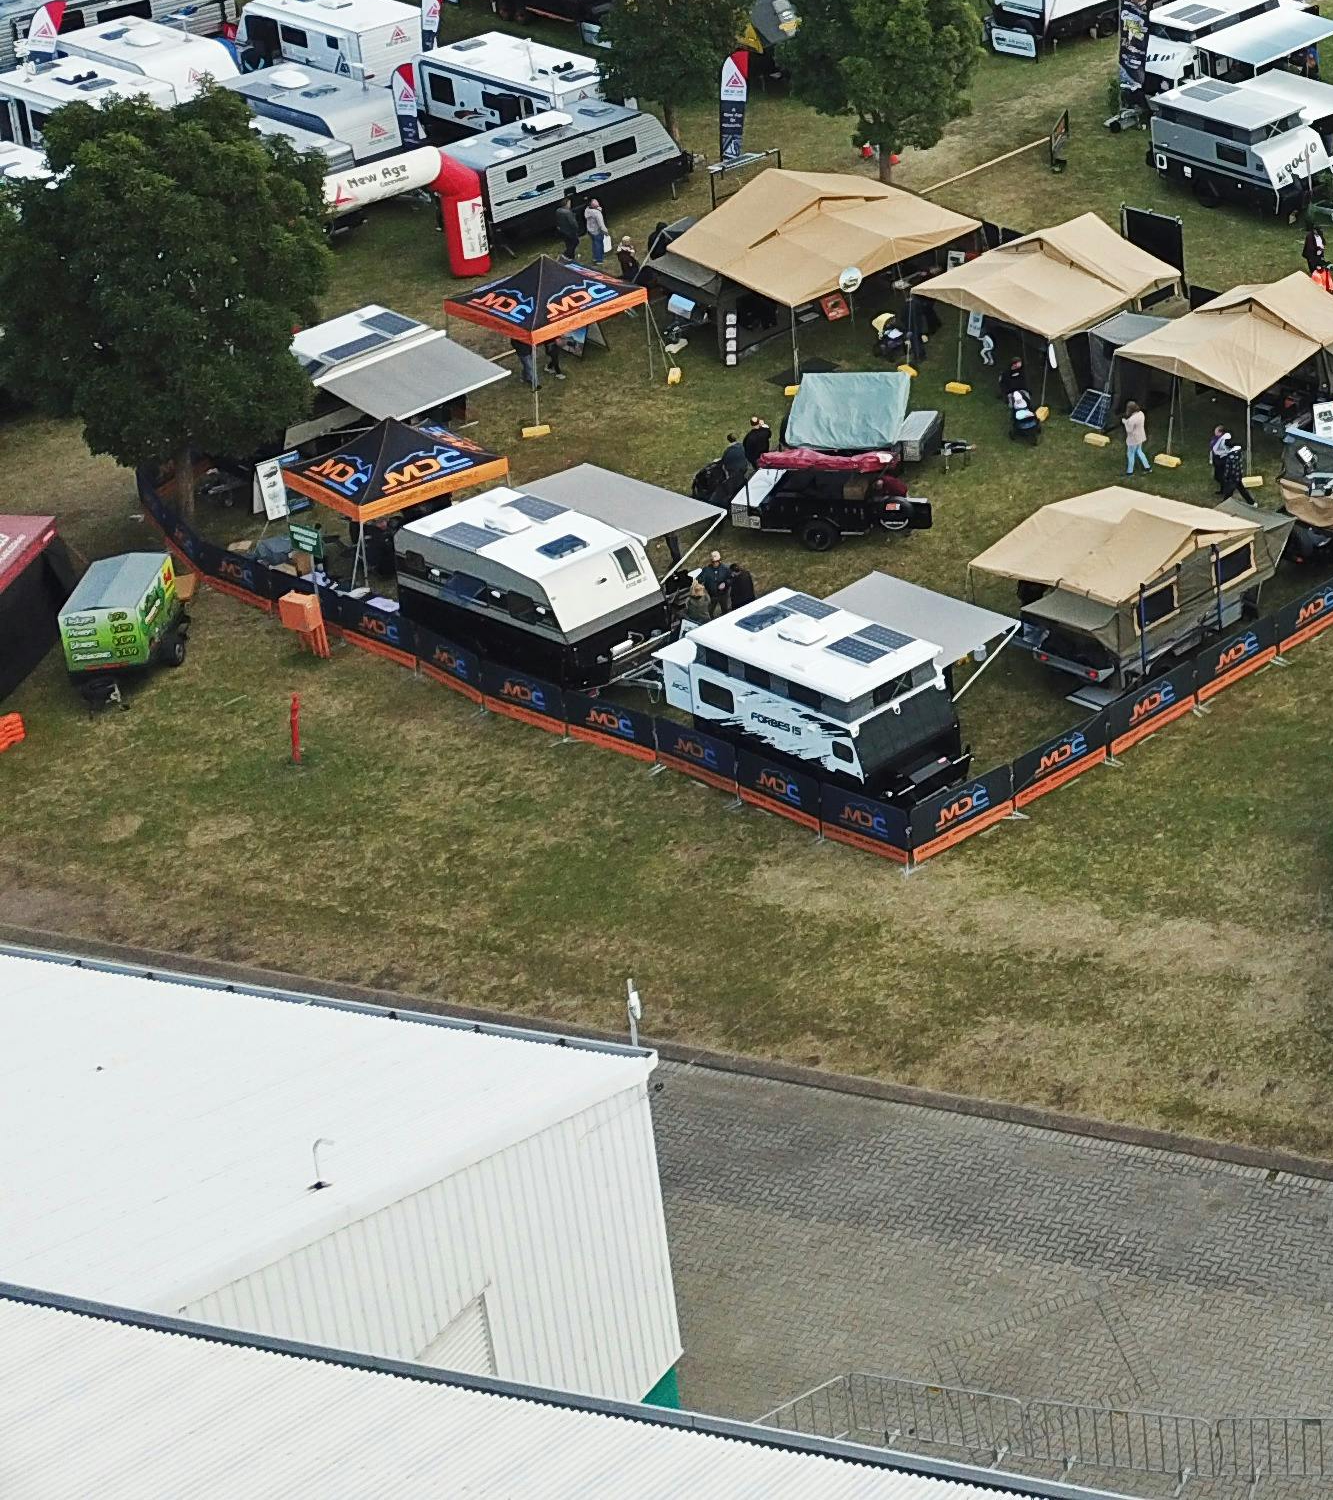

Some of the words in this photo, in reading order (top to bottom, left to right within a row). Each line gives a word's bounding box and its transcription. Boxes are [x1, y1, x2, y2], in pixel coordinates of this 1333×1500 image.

[347, 171, 379, 190] New
[381, 162, 409, 180] Age
[478, 290, 535, 322] MDC
[546, 283, 616, 319] MDC
[313, 458, 370, 488] MDC
[382, 450, 469, 489] MDC
[1215, 632, 1262, 674] MDC
[501, 680, 546, 710] MDC
[1129, 679, 1176, 726] MDC
[587, 709, 636, 740] MDC
[751, 711, 788, 735] FORBES
[674, 736, 718, 767] MDC
[1036, 734, 1088, 778] MDC
[756, 771, 802, 805] MDC
[838, 801, 889, 841] MDC
[935, 785, 990, 829] MDC
